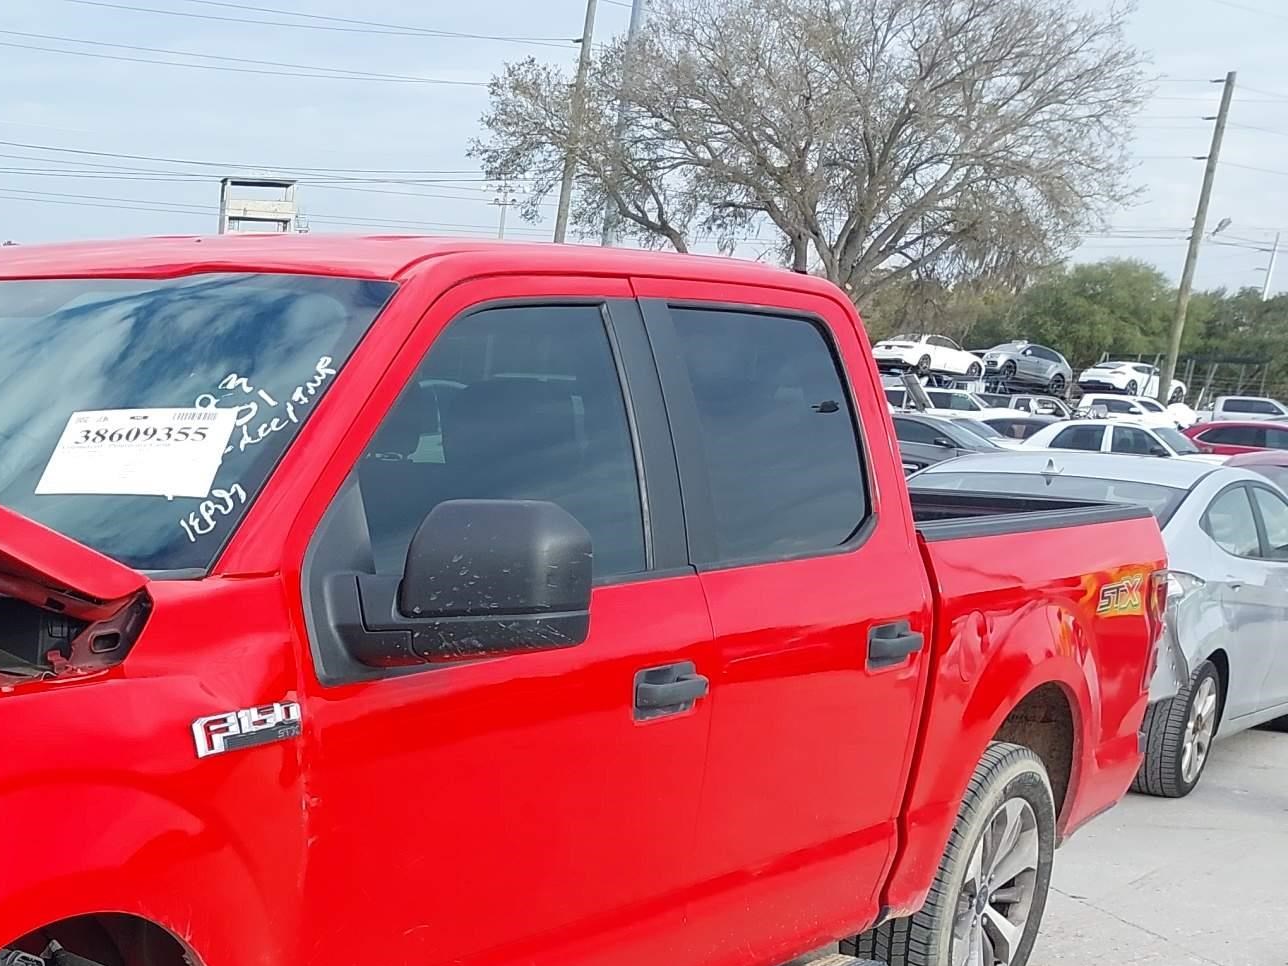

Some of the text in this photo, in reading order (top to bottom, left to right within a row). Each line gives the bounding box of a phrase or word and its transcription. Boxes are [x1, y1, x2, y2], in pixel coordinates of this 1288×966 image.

[74, 427, 209, 445] 38609355
[1096, 574, 1143, 613] STX
[277, 726, 300, 738] STX
